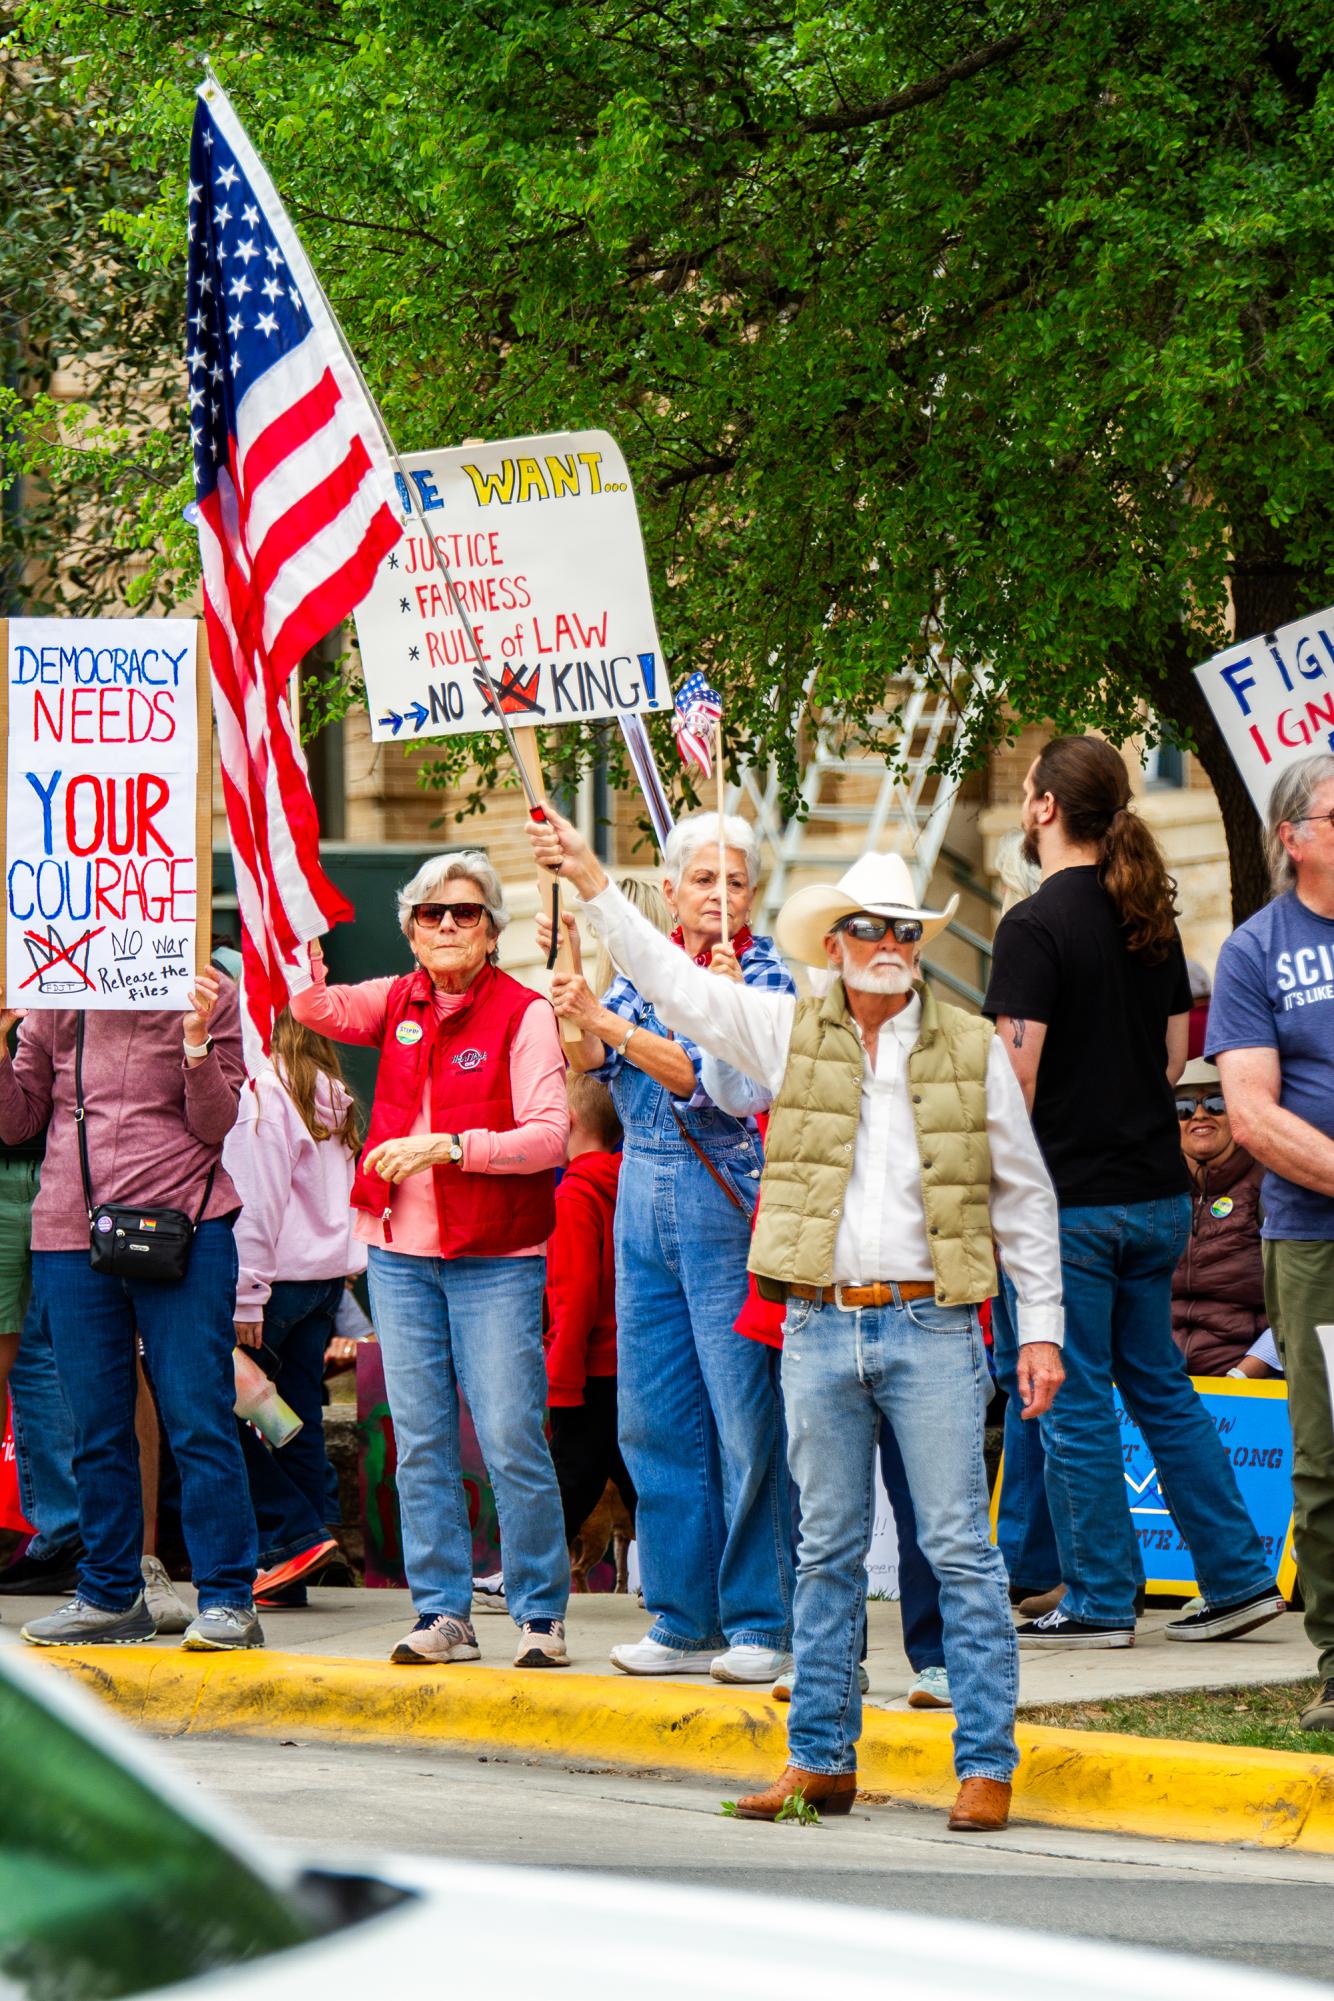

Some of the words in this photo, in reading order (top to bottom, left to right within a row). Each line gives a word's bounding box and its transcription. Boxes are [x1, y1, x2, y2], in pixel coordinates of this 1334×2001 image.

[461, 452, 628, 506] WANT...
[405, 532, 504, 574] JUSTICE
[415, 576, 531, 619] FAIRNESS
[425, 626, 492, 668] RULE
[501, 624, 523, 658] of
[533, 611, 608, 654] LAW
[12, 646, 188, 686] DEMOCRACY
[428, 681, 464, 724] NO
[549, 653, 661, 713] KING!
[34, 687, 176, 743] NEEDS
[25, 769, 174, 857] YOUR
[8, 857, 197, 922] COURAGE
[111, 928, 143, 957] NO
[97, 967, 157, 995] Release
[160, 964, 188, 979] the
[1276, 944, 1334, 991] SCI
[128, 986, 169, 1001] files
[1284, 991, 1305, 1011] IT'S
[1305, 984, 1334, 1004] LIKE
